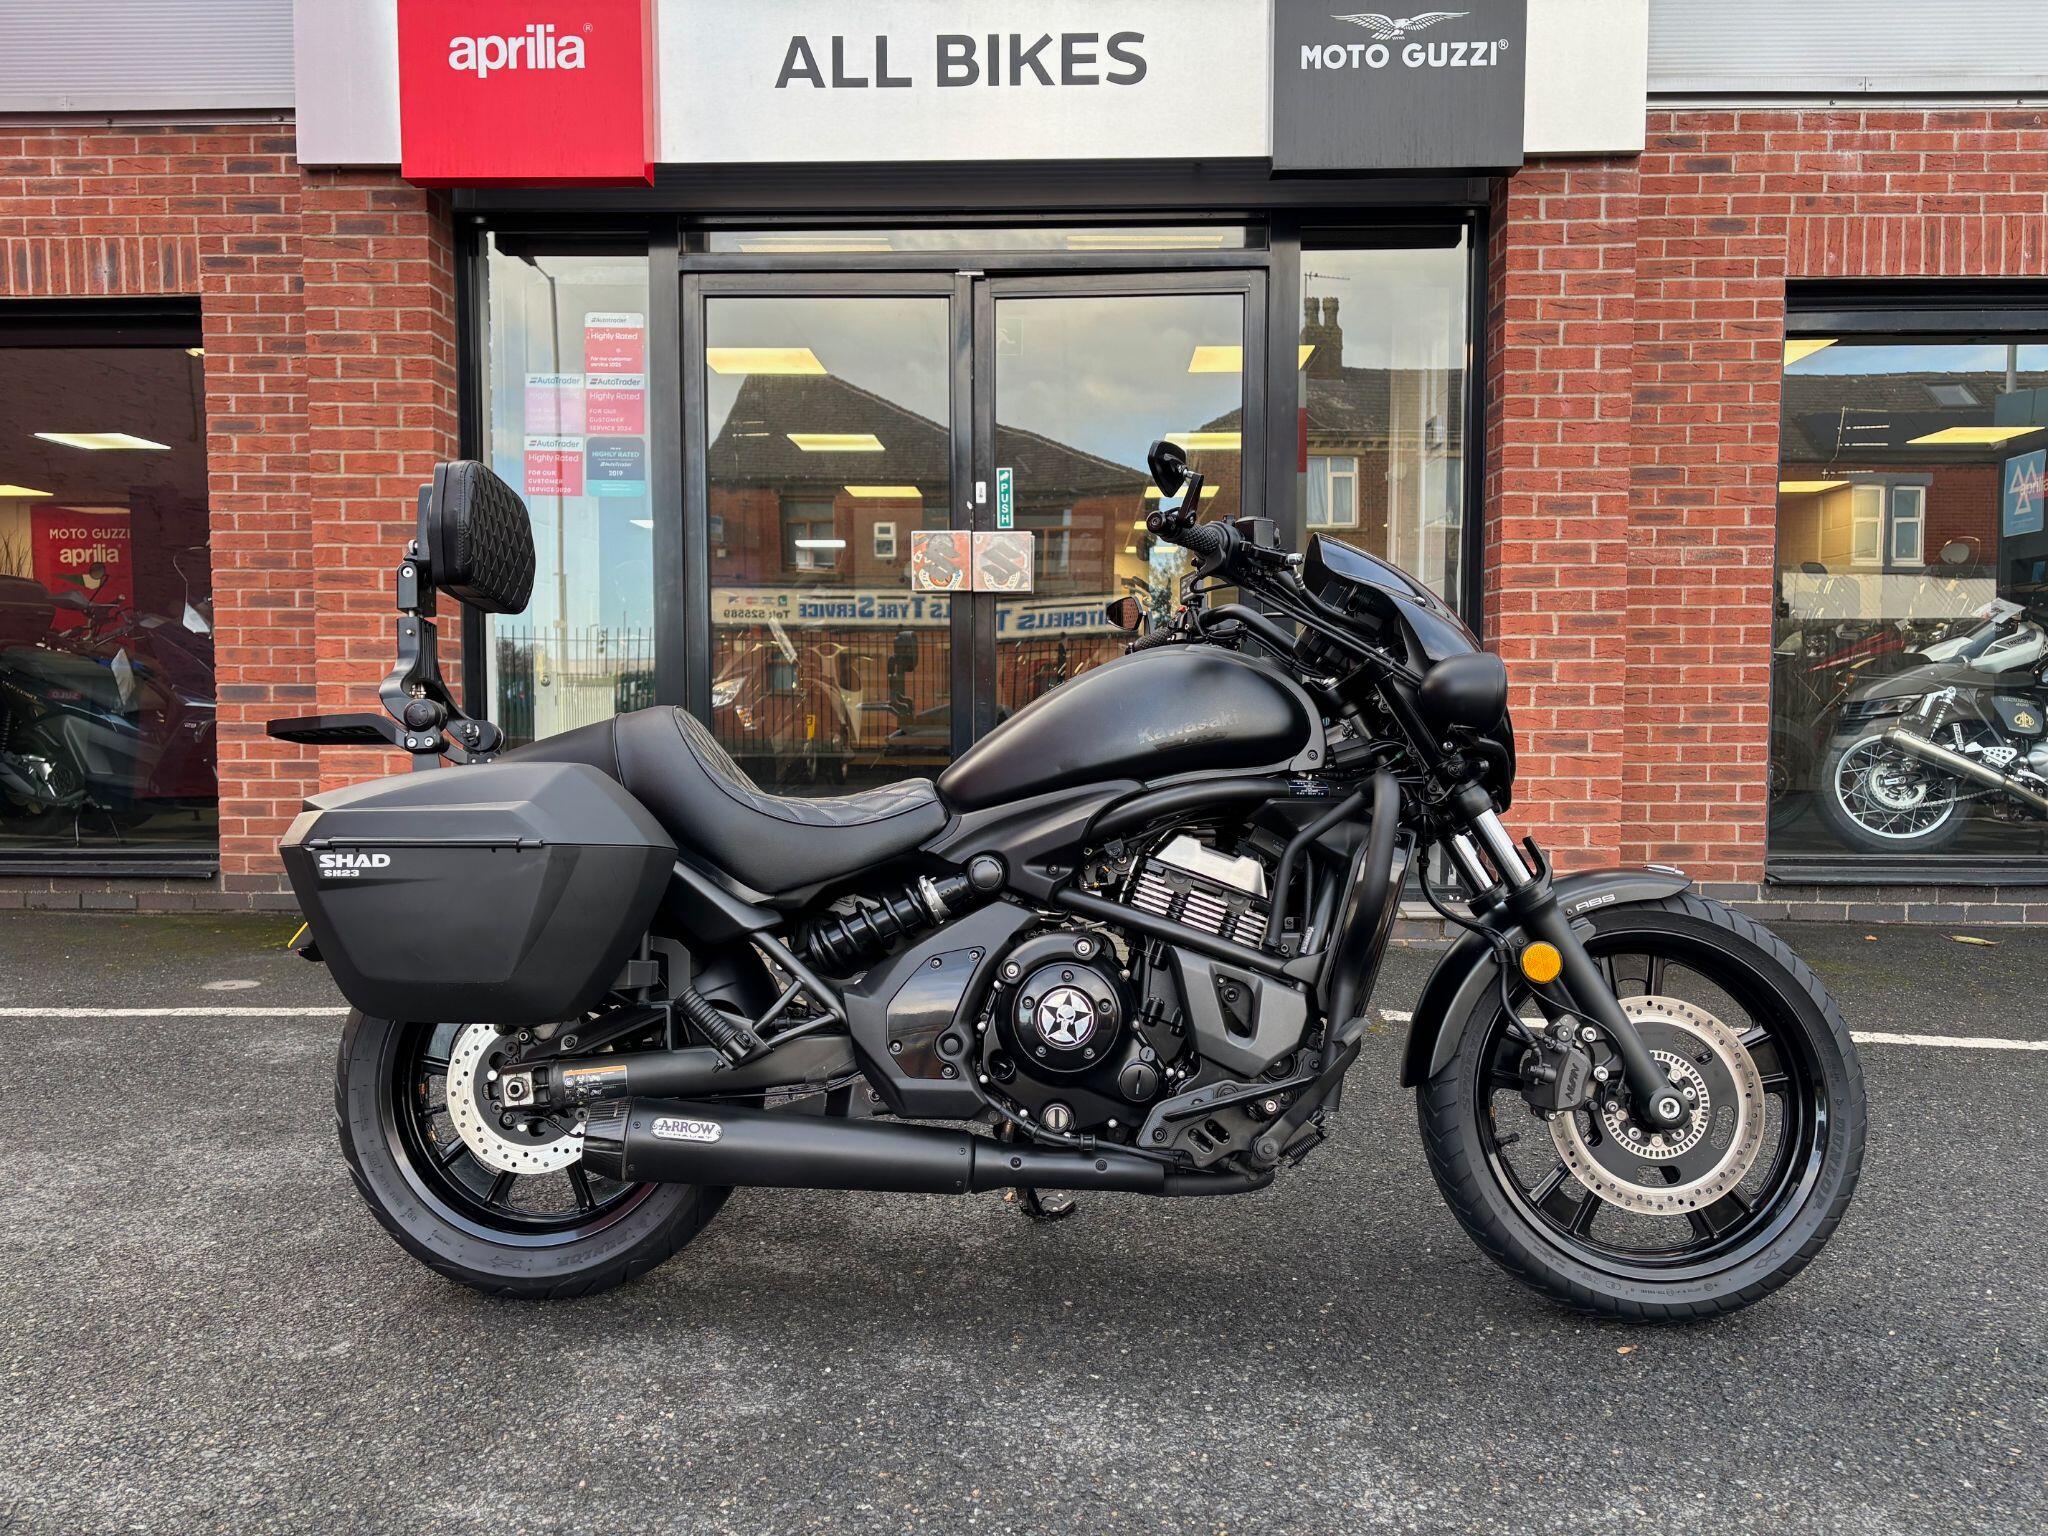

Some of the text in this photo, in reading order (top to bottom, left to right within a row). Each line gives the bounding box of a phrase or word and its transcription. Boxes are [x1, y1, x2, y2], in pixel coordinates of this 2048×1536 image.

[448, 24, 586, 79] aprilia
[1301, 41, 1498, 70] MOTO GUZZI
[775, 31, 1148, 88] ALL BIKES
[590, 332, 638, 341] Highly Rated
[537, 376, 580, 384] AutoTrader
[597, 378, 641, 386] AutoTrader
[590, 392, 640, 401] Highly Rated
[537, 440, 580, 448] AutoTrader
[528, 453, 579, 463] Highly Rated
[1000, 483, 1010, 524] PUSH
[49, 527, 131, 539] MOTO GUZZI
[59, 543, 119, 567] aprilia
[319, 853, 391, 868] SHAD
[323, 869, 360, 877] SH23
[1575, 893, 1616, 912] ABS
[659, 1119, 716, 1135] ARROW
